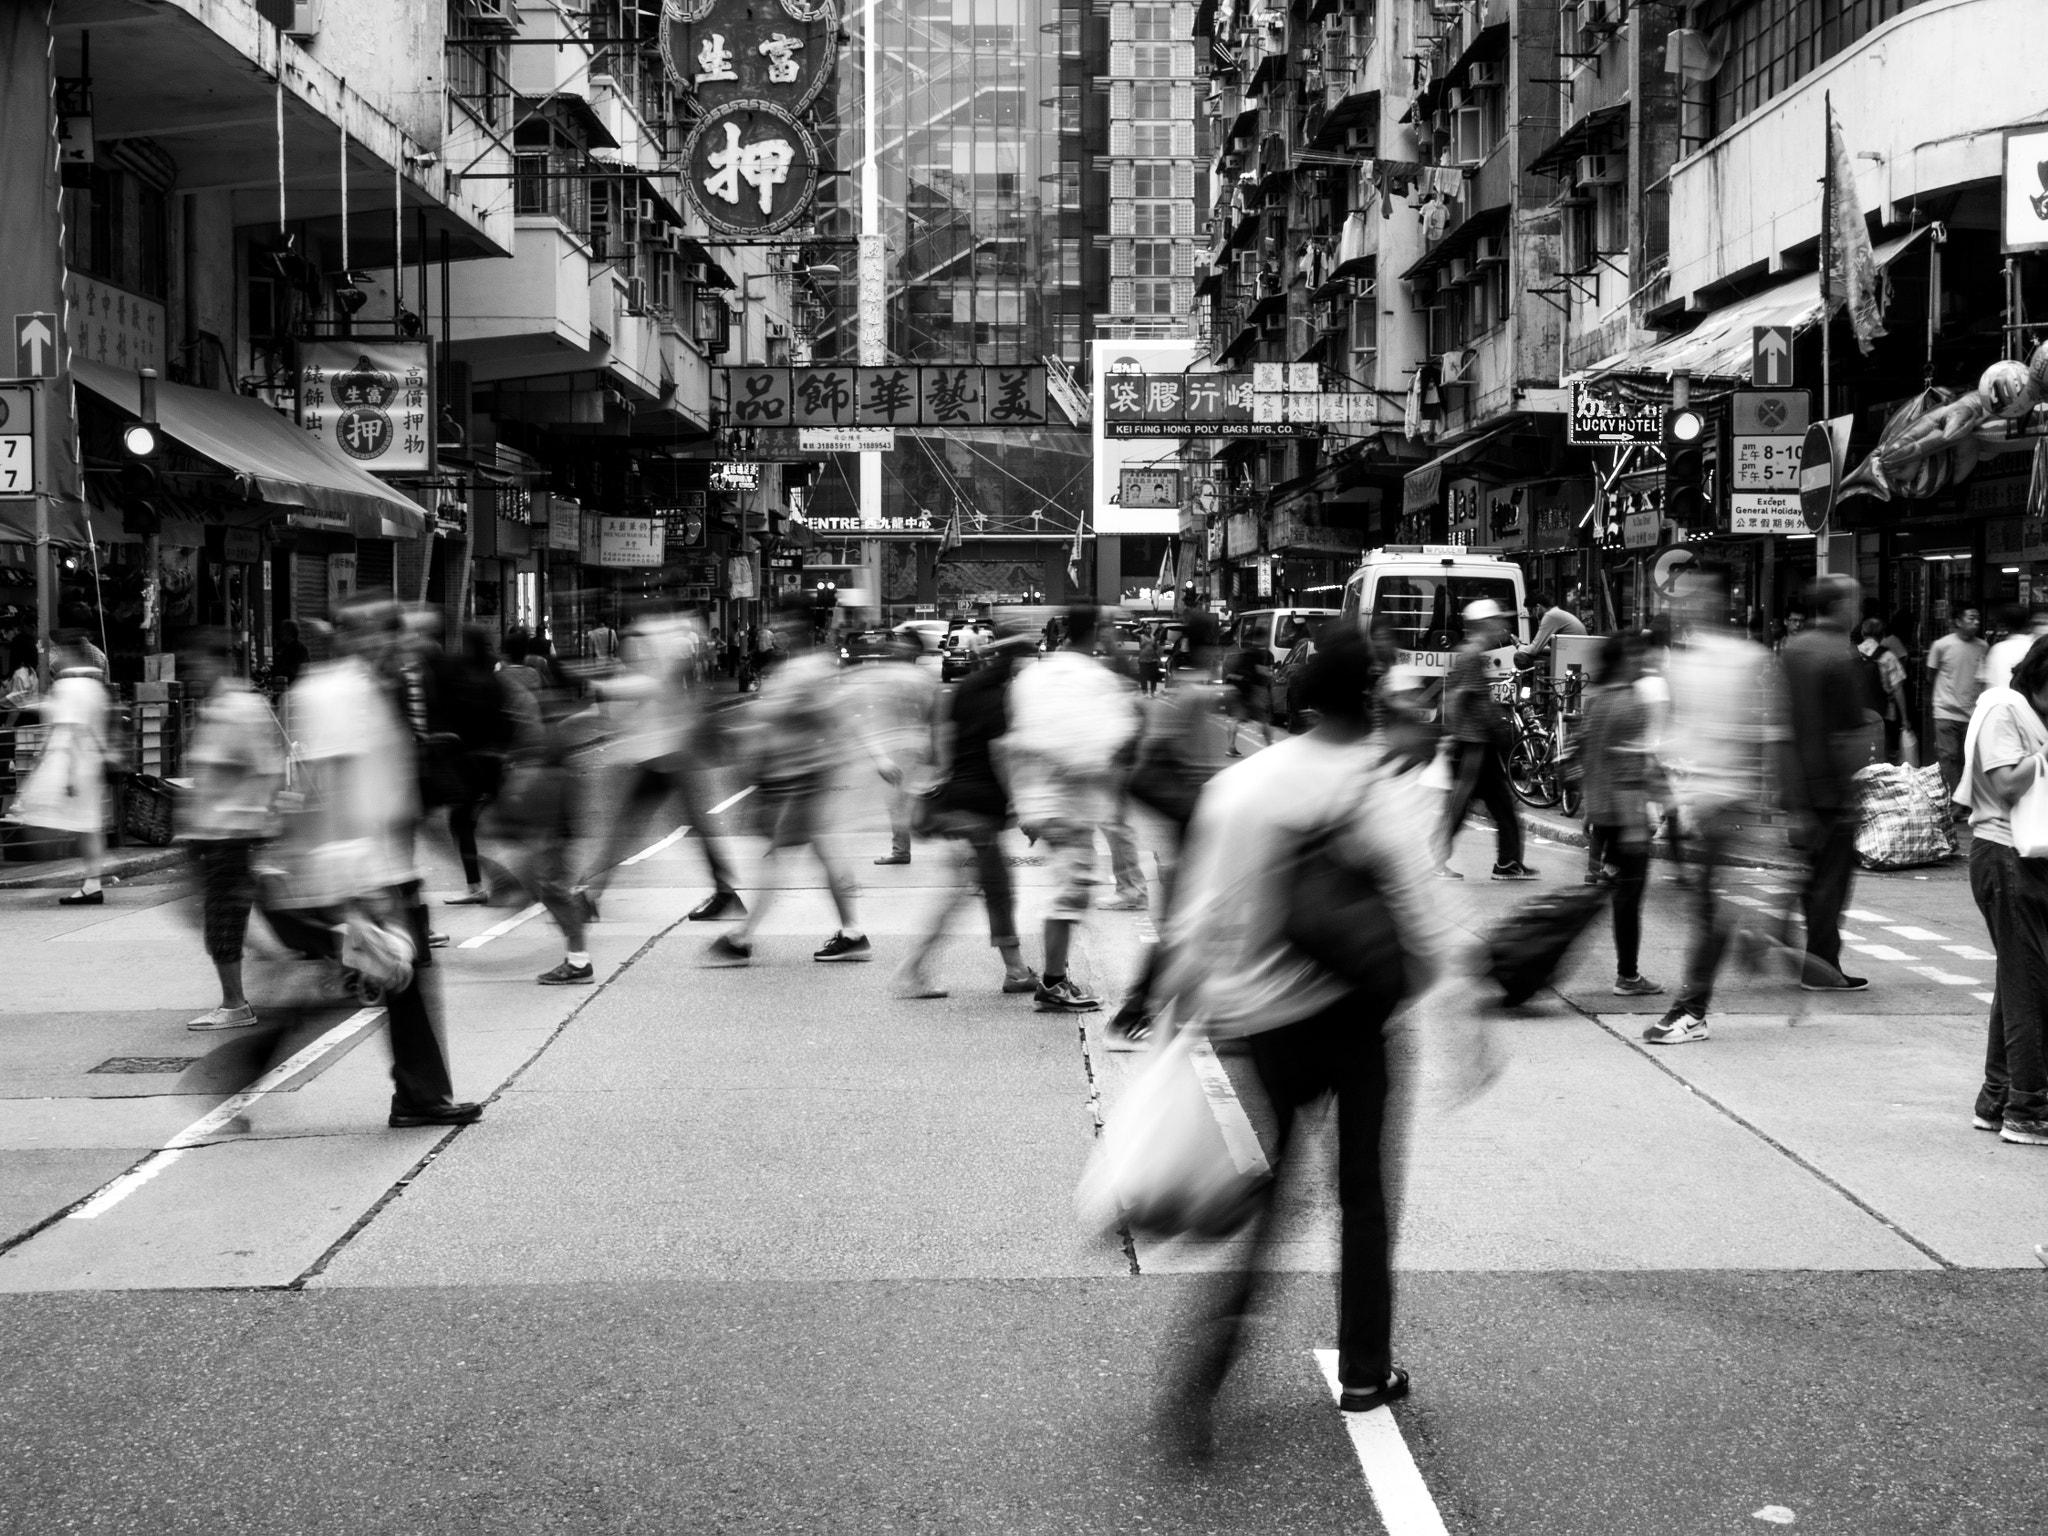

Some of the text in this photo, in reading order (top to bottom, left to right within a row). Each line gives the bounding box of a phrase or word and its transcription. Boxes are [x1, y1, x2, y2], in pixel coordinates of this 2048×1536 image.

[704, 122, 795, 215] 押
[304, 365, 325, 439] 錶飾出
[1110, 381, 1289, 413] 峰行膠袋
[403, 367, 425, 454] 高價押物
[1116, 426, 1132, 434] KEI
[1135, 426, 1160, 434] FUNG
[1164, 426, 1191, 434] HONG
[1195, 426, 1219, 434] POLY
[1222, 426, 1248, 434] BAGS
[1278, 426, 1294, 434] CO.
[1575, 419, 1658, 431] LUCKY HOTEL
[347, 413, 383, 451] 押
[4, 440, 17, 458] 7
[1738, 451, 1760, 461] 上午
[1742, 463, 1756, 471] pm
[4, 470, 17, 488] 7
[1738, 472, 1760, 482] 下午
[1757, 498, 1786, 506] Except
[1735, 506, 1802, 516] General Holiday
[865, 517, 931, 530] 西九龍中心
[1735, 518, 1806, 529] 公眾假期例外
[1416, 652, 1462, 667] POLI
